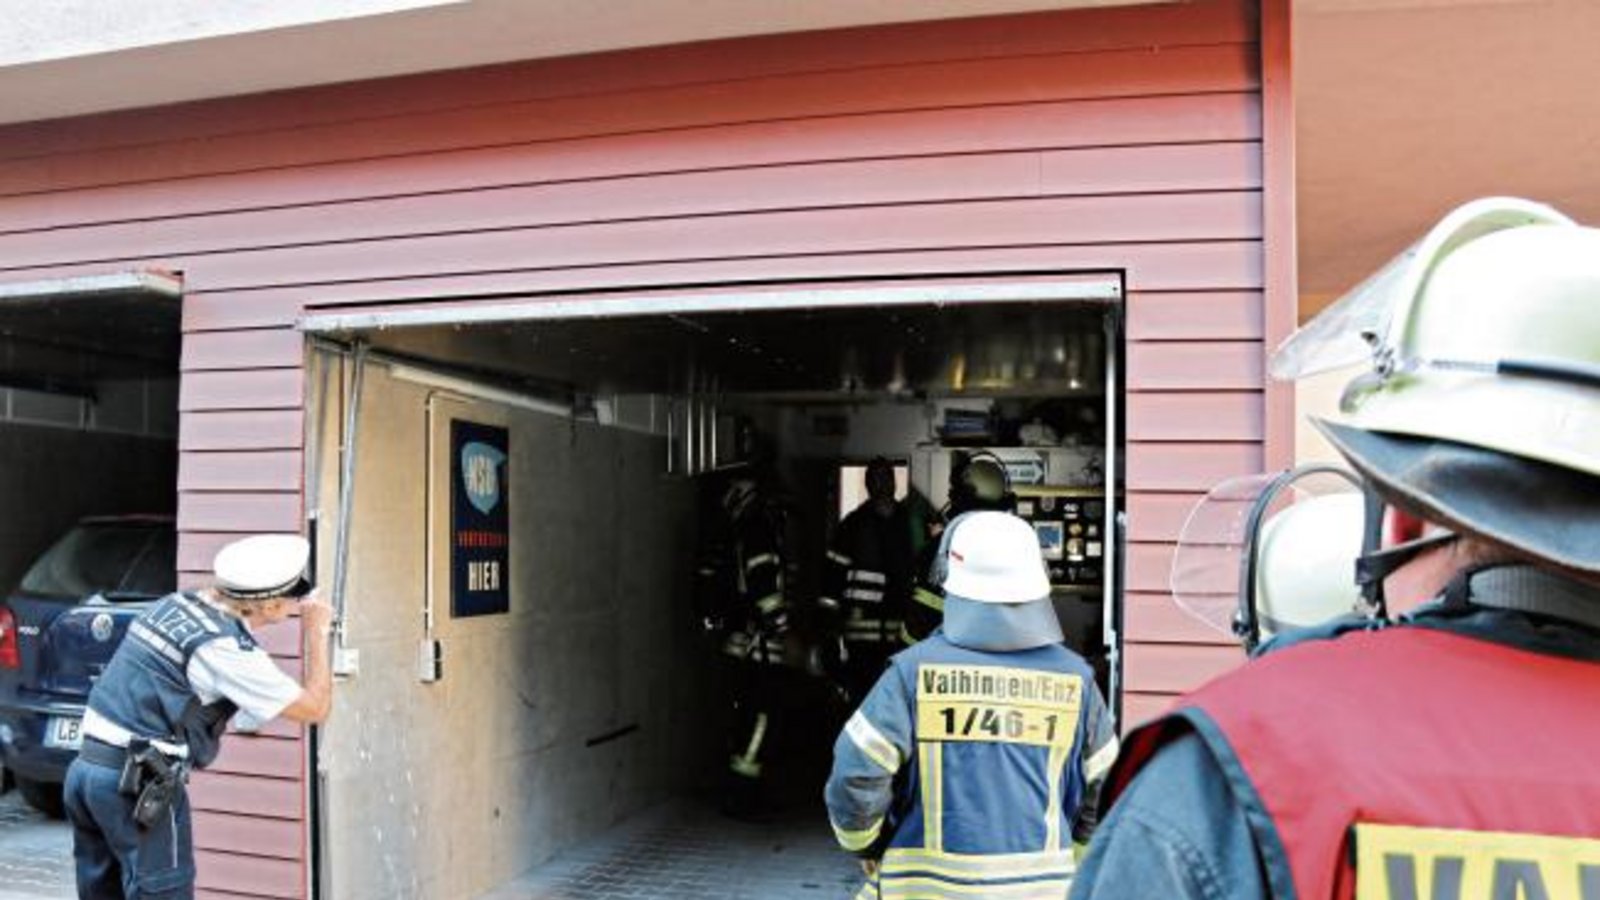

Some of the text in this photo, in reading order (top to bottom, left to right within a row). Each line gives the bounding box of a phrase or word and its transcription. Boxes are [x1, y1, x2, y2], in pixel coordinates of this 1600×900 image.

[468, 561, 499, 591] HIER
[923, 669, 1076, 703] Vaihingen/Enz
[58, 718, 80, 741] LB
[940, 707, 1058, 741] 1/46-1
